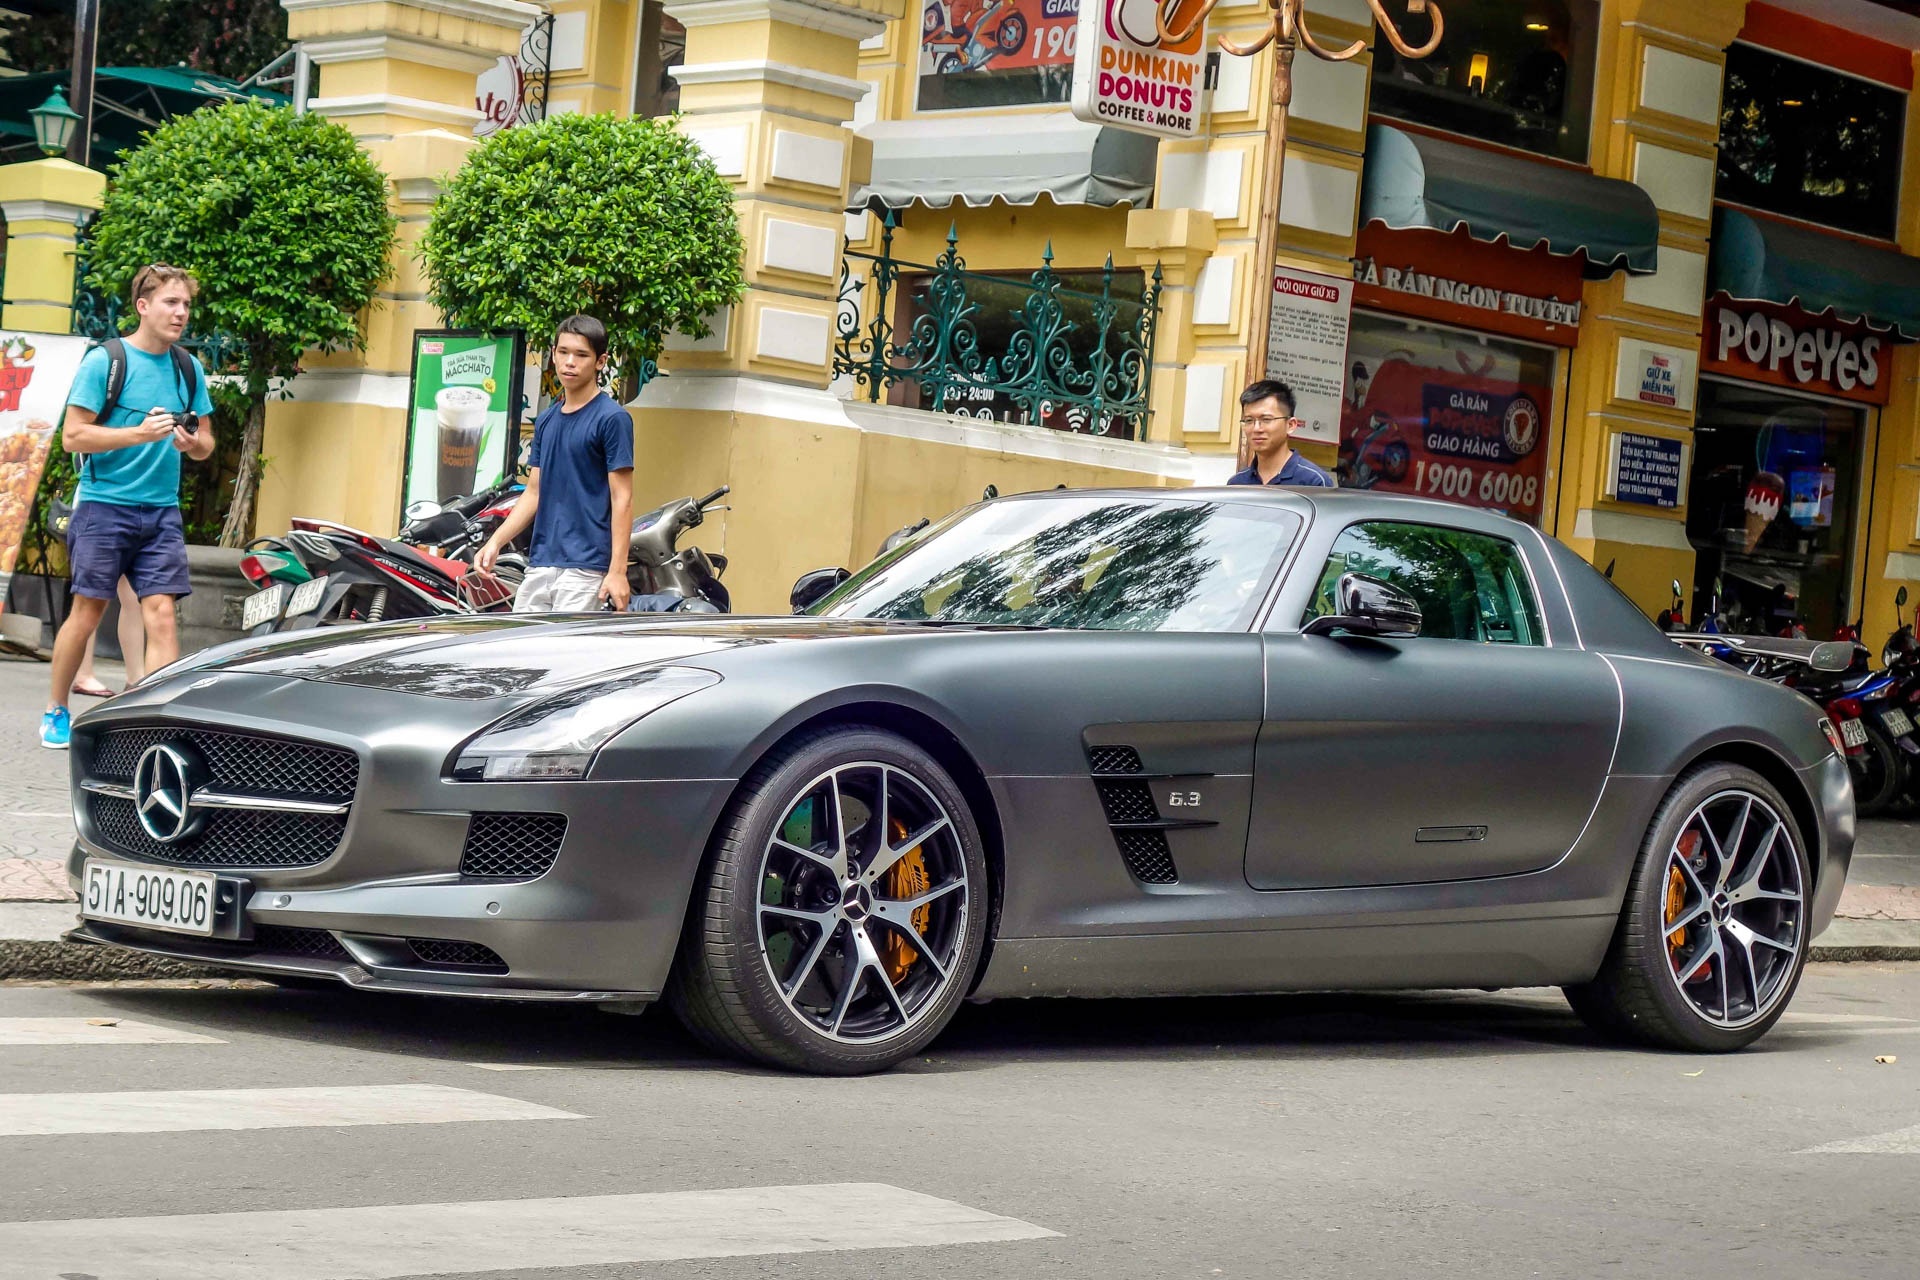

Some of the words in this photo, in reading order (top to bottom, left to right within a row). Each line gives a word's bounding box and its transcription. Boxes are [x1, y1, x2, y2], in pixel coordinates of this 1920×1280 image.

[1101, 45, 1199, 86] DUNKIN'
[1099, 72, 1192, 113] DONUTS
[1098, 101, 1145, 122] COFFEE
[1146, 110, 1154, 123] &
[1156, 112, 1192, 131] MORE
[1276, 279, 1292, 293] NỘI
[1292, 283, 1310, 295] QUY
[1310, 285, 1326, 297] GIỮ
[1326, 289, 1336, 300] XE
[1384, 265, 1436, 297] RÁN
[1436, 278, 1502, 311] NGON
[445, 363, 491, 380] MACCHIATO
[1662, 371, 1672, 381] XE
[1662, 384, 1675, 396] PHÍ
[1450, 392, 1465, 408] GÀ
[1466, 395, 1488, 412] RÁN
[1427, 433, 1459, 452] GIAO
[1462, 436, 1500, 458] HÀNG
[1415, 460, 1473, 498] 1900
[1479, 470, 1538, 507] 6008
[398, 566, 439, 588] BLADE
[1169, 792, 1201, 806] 6.3
[88, 867, 208, 926] 51A-909.06
